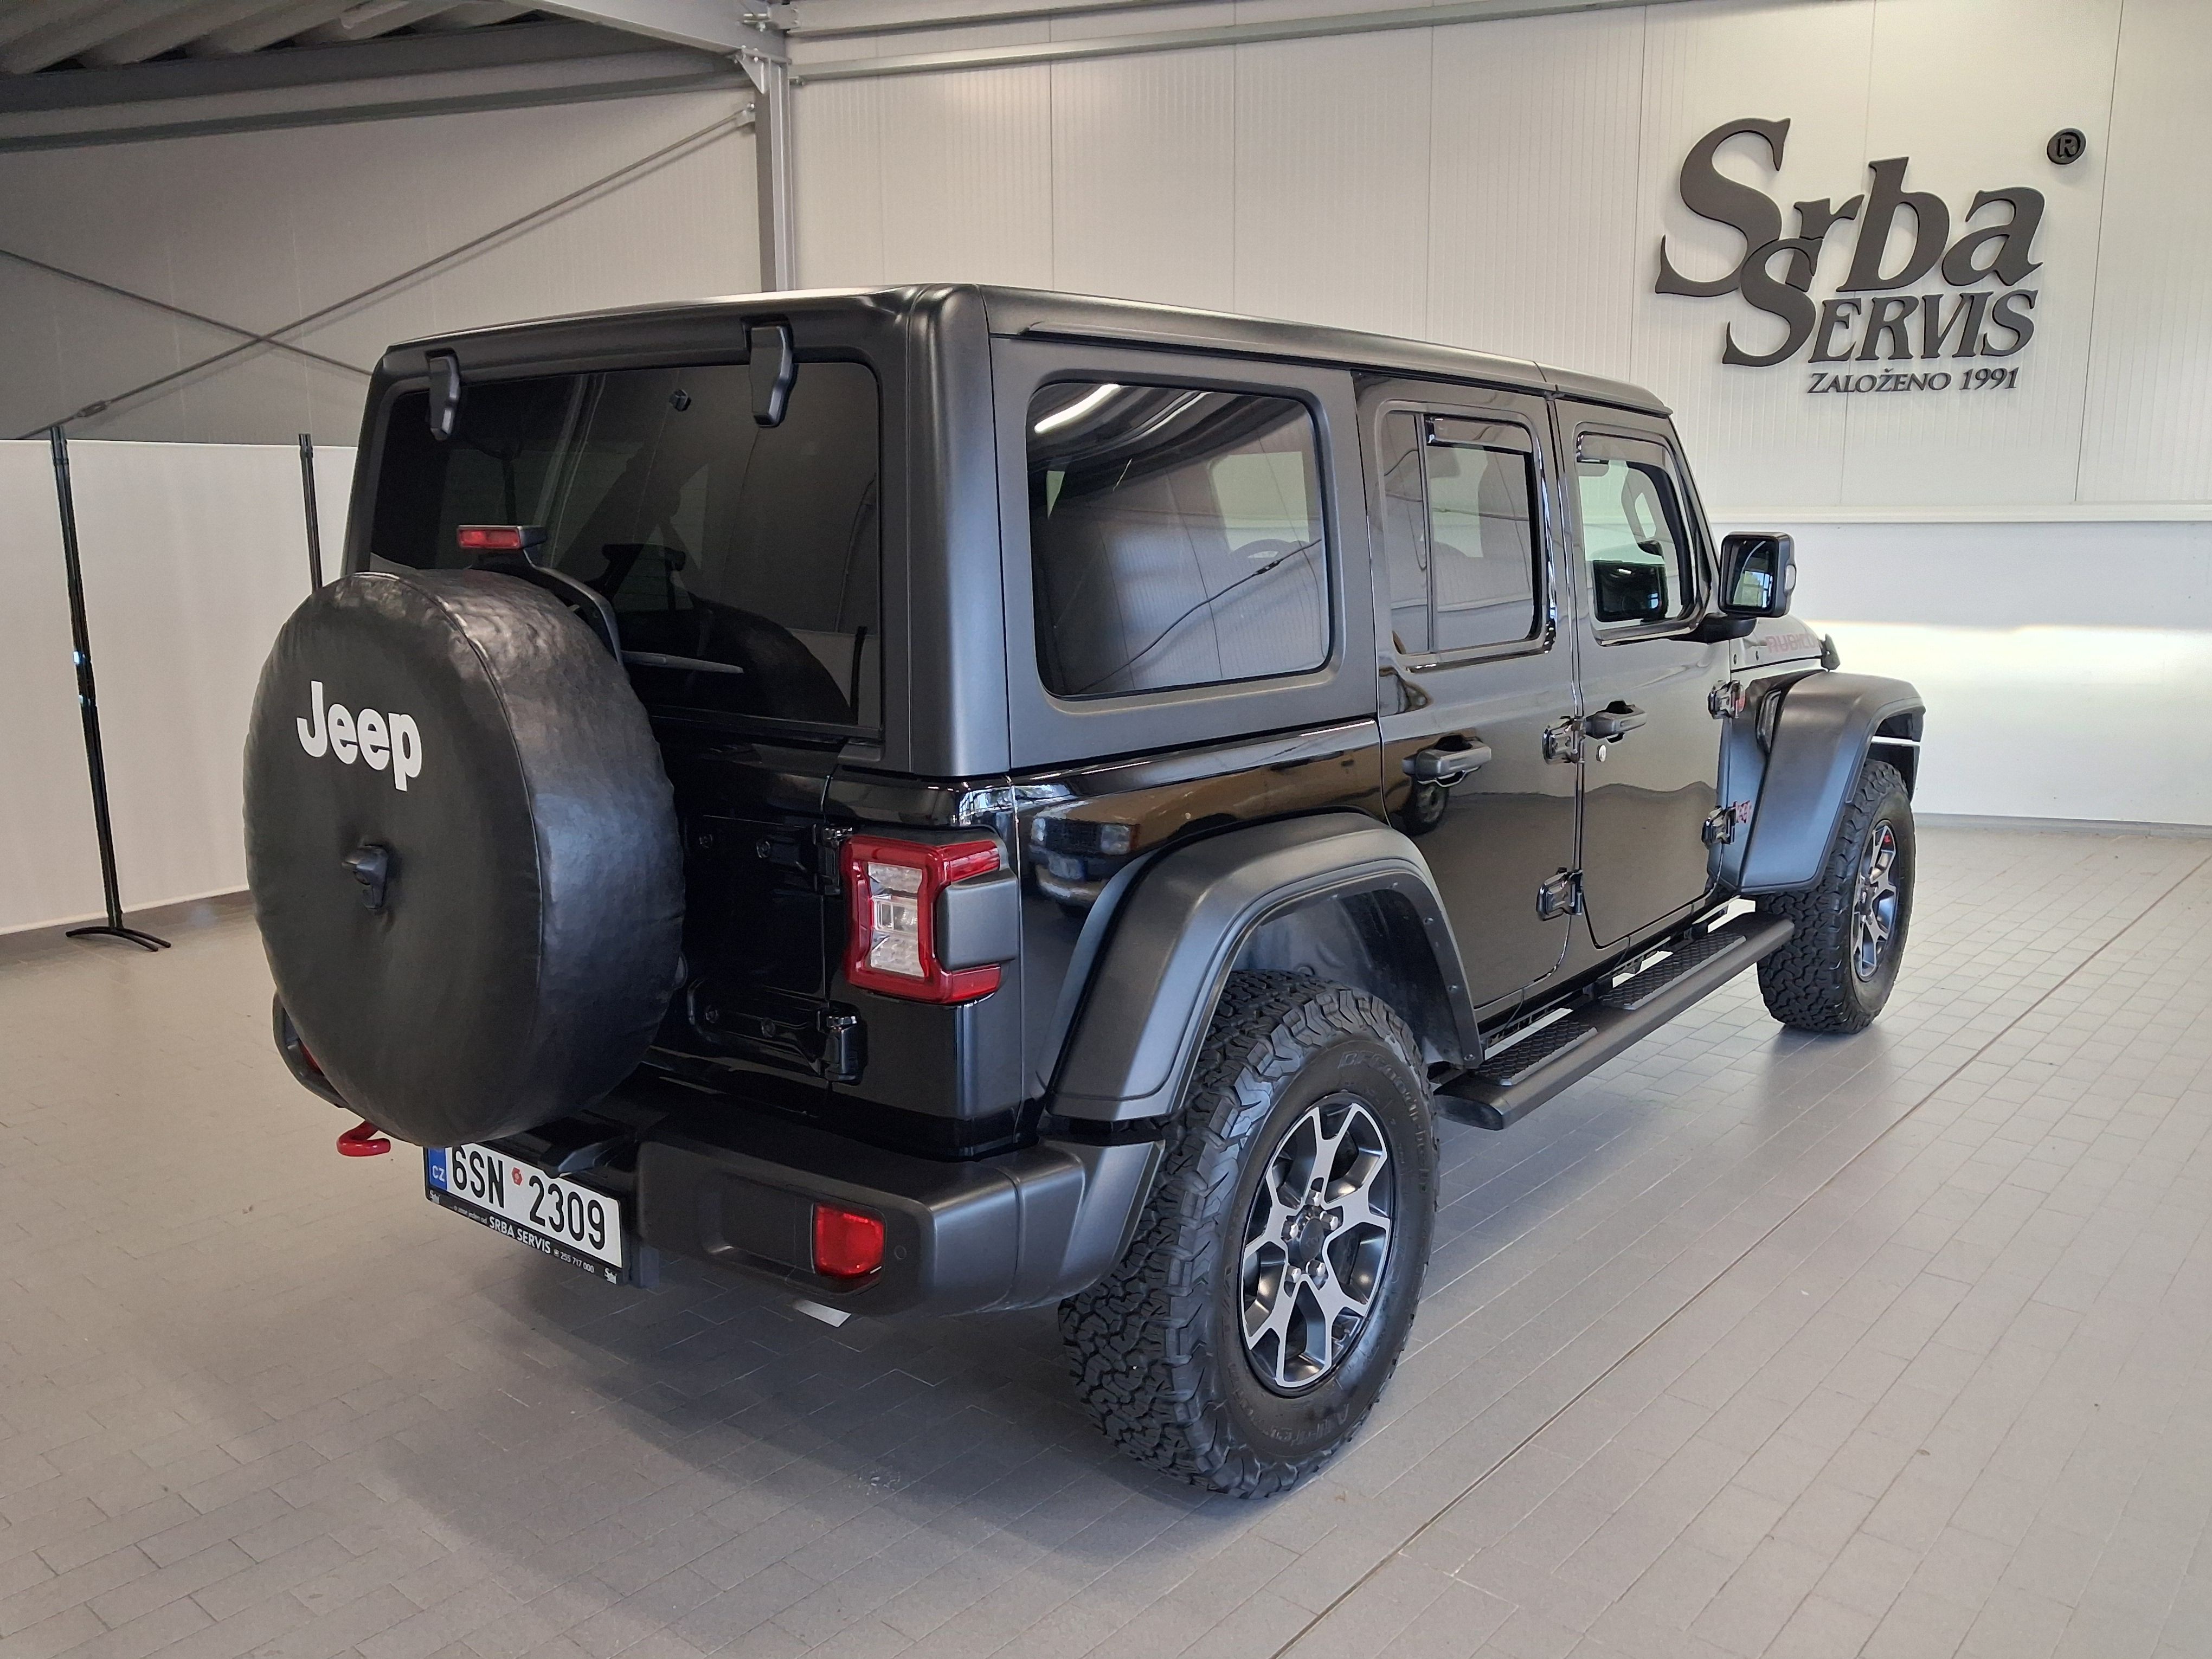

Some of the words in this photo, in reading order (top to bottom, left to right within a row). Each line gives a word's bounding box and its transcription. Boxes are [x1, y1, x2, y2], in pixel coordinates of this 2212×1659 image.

[1655, 118, 2044, 297] Srba
[1722, 238, 2039, 366] SERVIS
[1807, 368, 1952, 394] ZALOŽENO
[1959, 366, 2019, 390] 1991
[297, 680, 422, 792] Jeep
[432, 1165, 445, 1182] CZ
[452, 1146, 505, 1209] 6SN
[529, 1175, 605, 1251] 2309
[489, 1216, 515, 1239] SRBA
[517, 1227, 551, 1255] SERVIS
